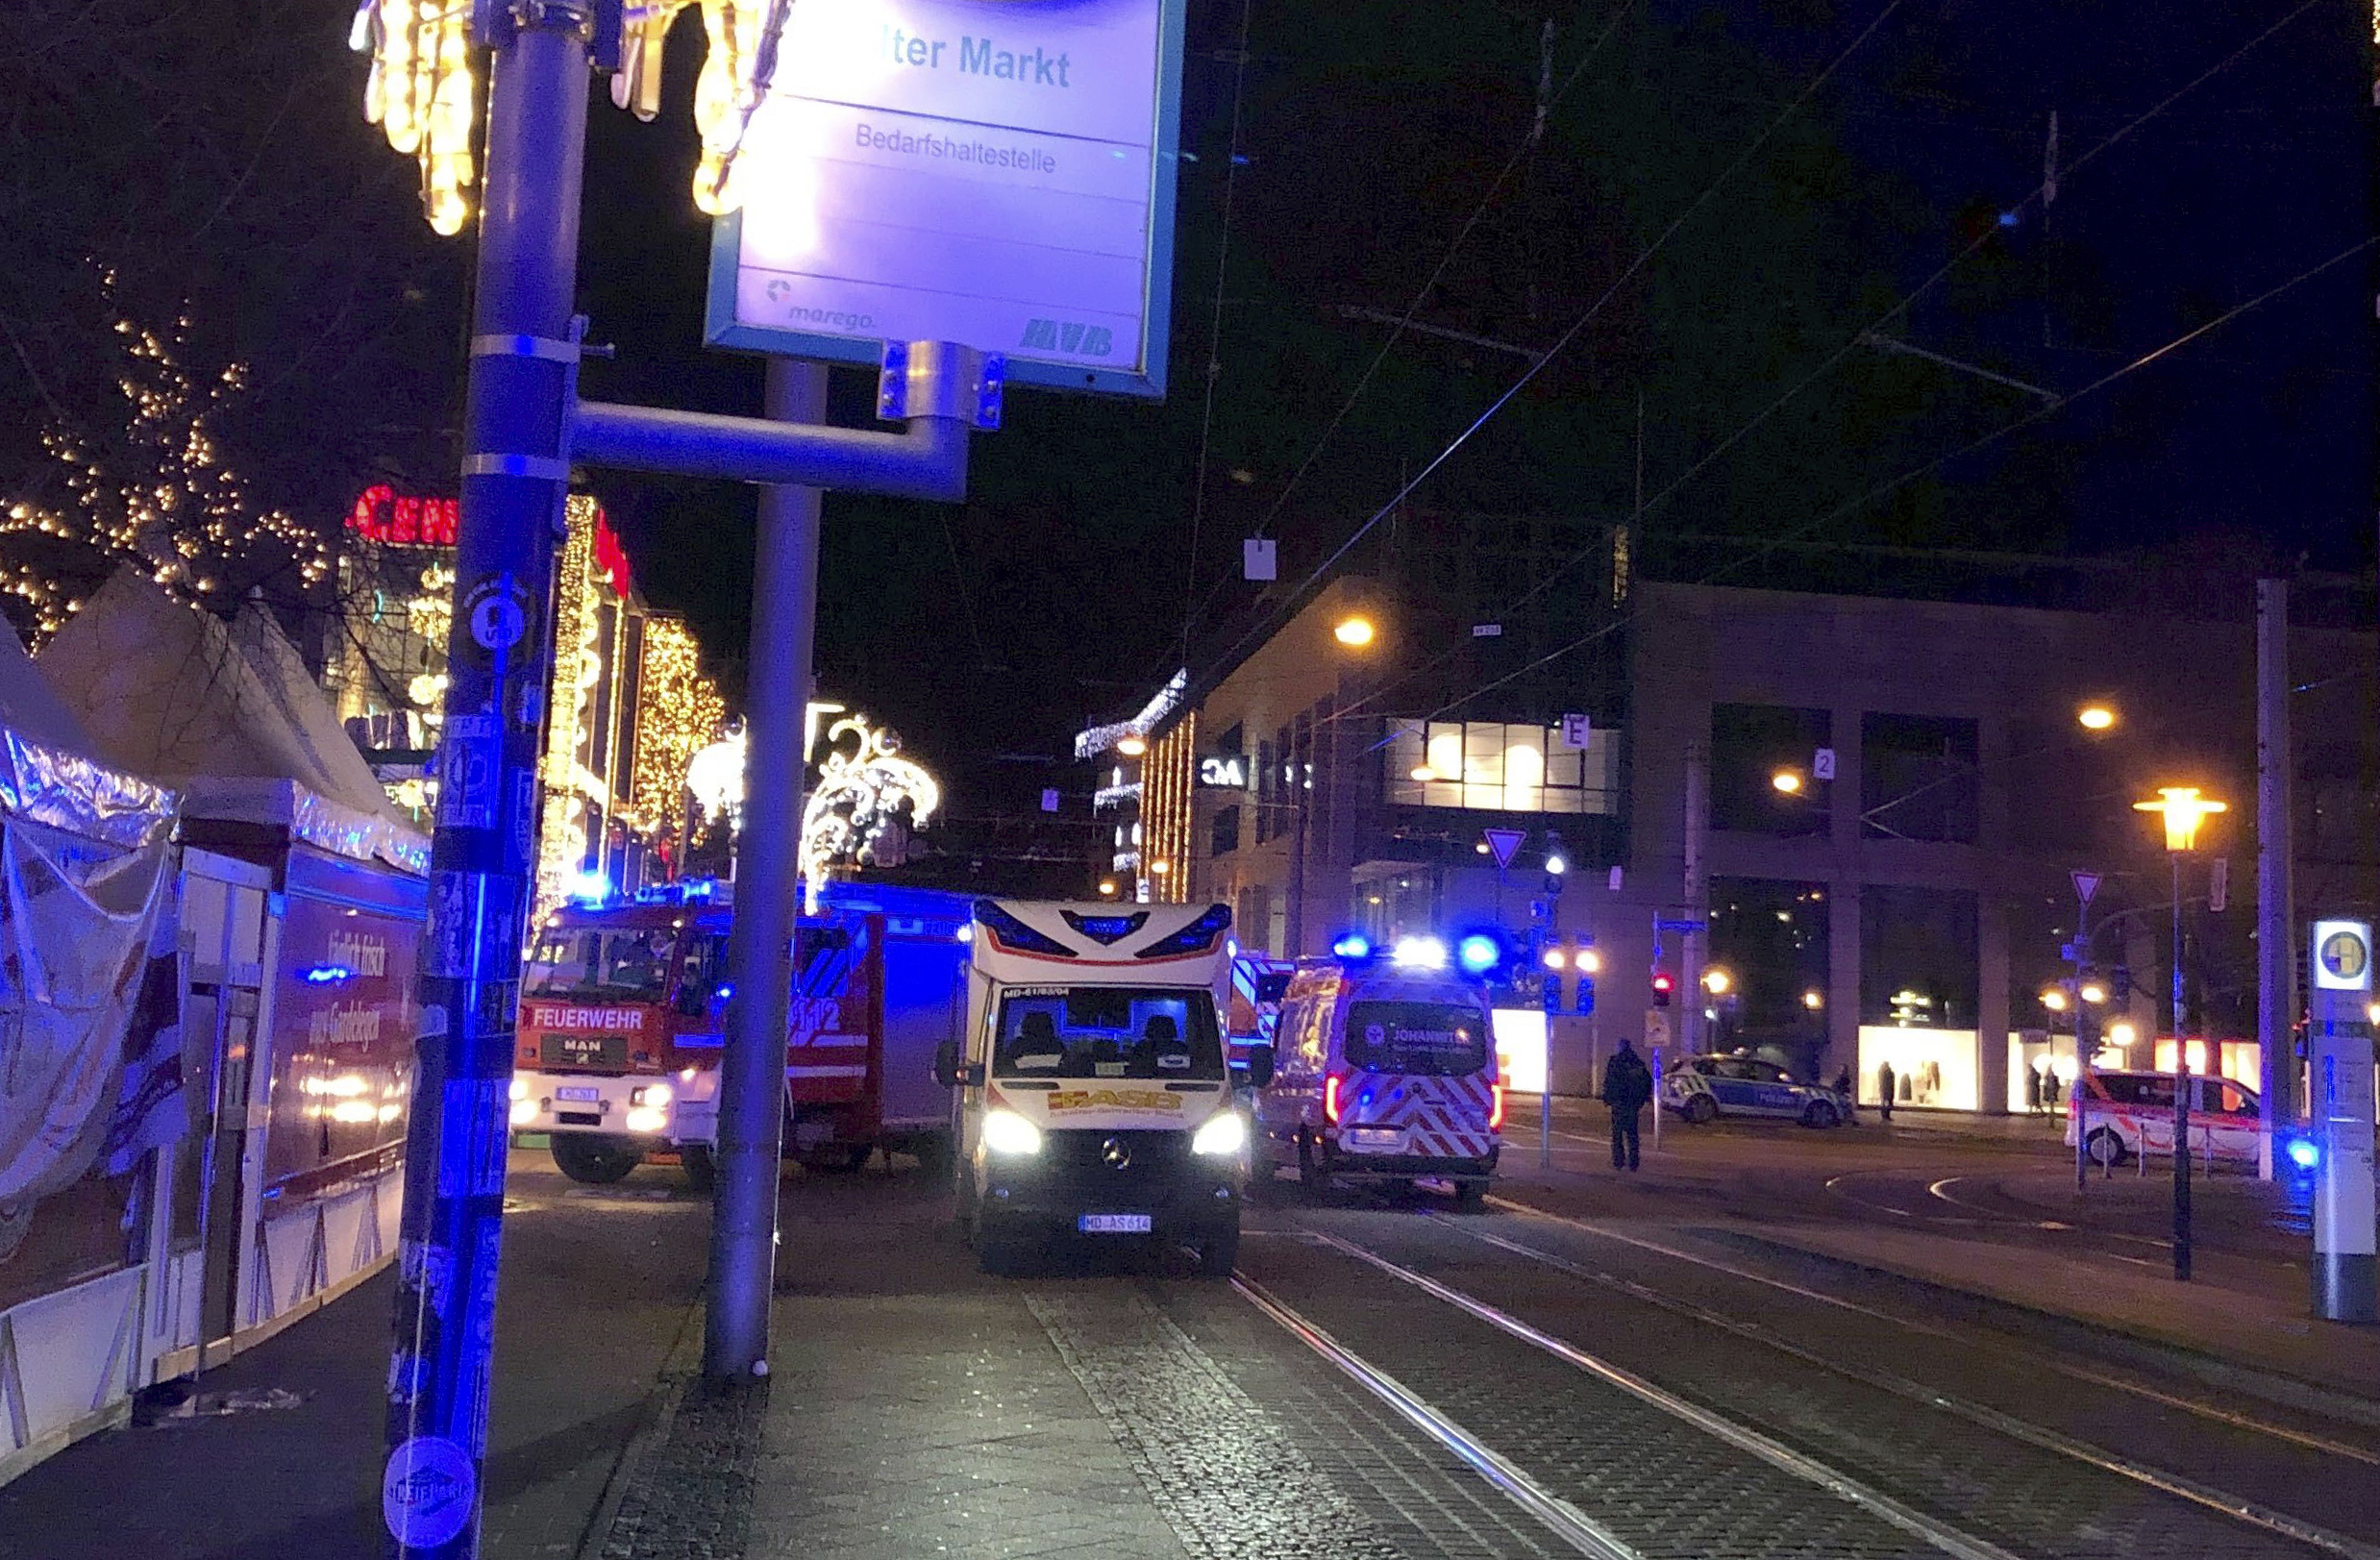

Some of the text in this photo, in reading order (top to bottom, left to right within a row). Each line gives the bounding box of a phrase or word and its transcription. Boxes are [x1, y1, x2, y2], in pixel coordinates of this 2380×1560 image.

[879, 24, 1071, 87] lter Markt
[855, 124, 1057, 173] Bedarfshaltestelle
[1018, 318, 1112, 357] MVB
[1819, 755, 1830, 773] 2
[533, 1008, 642, 1029] FEUERWEHR
[564, 1040, 601, 1051] MAN
